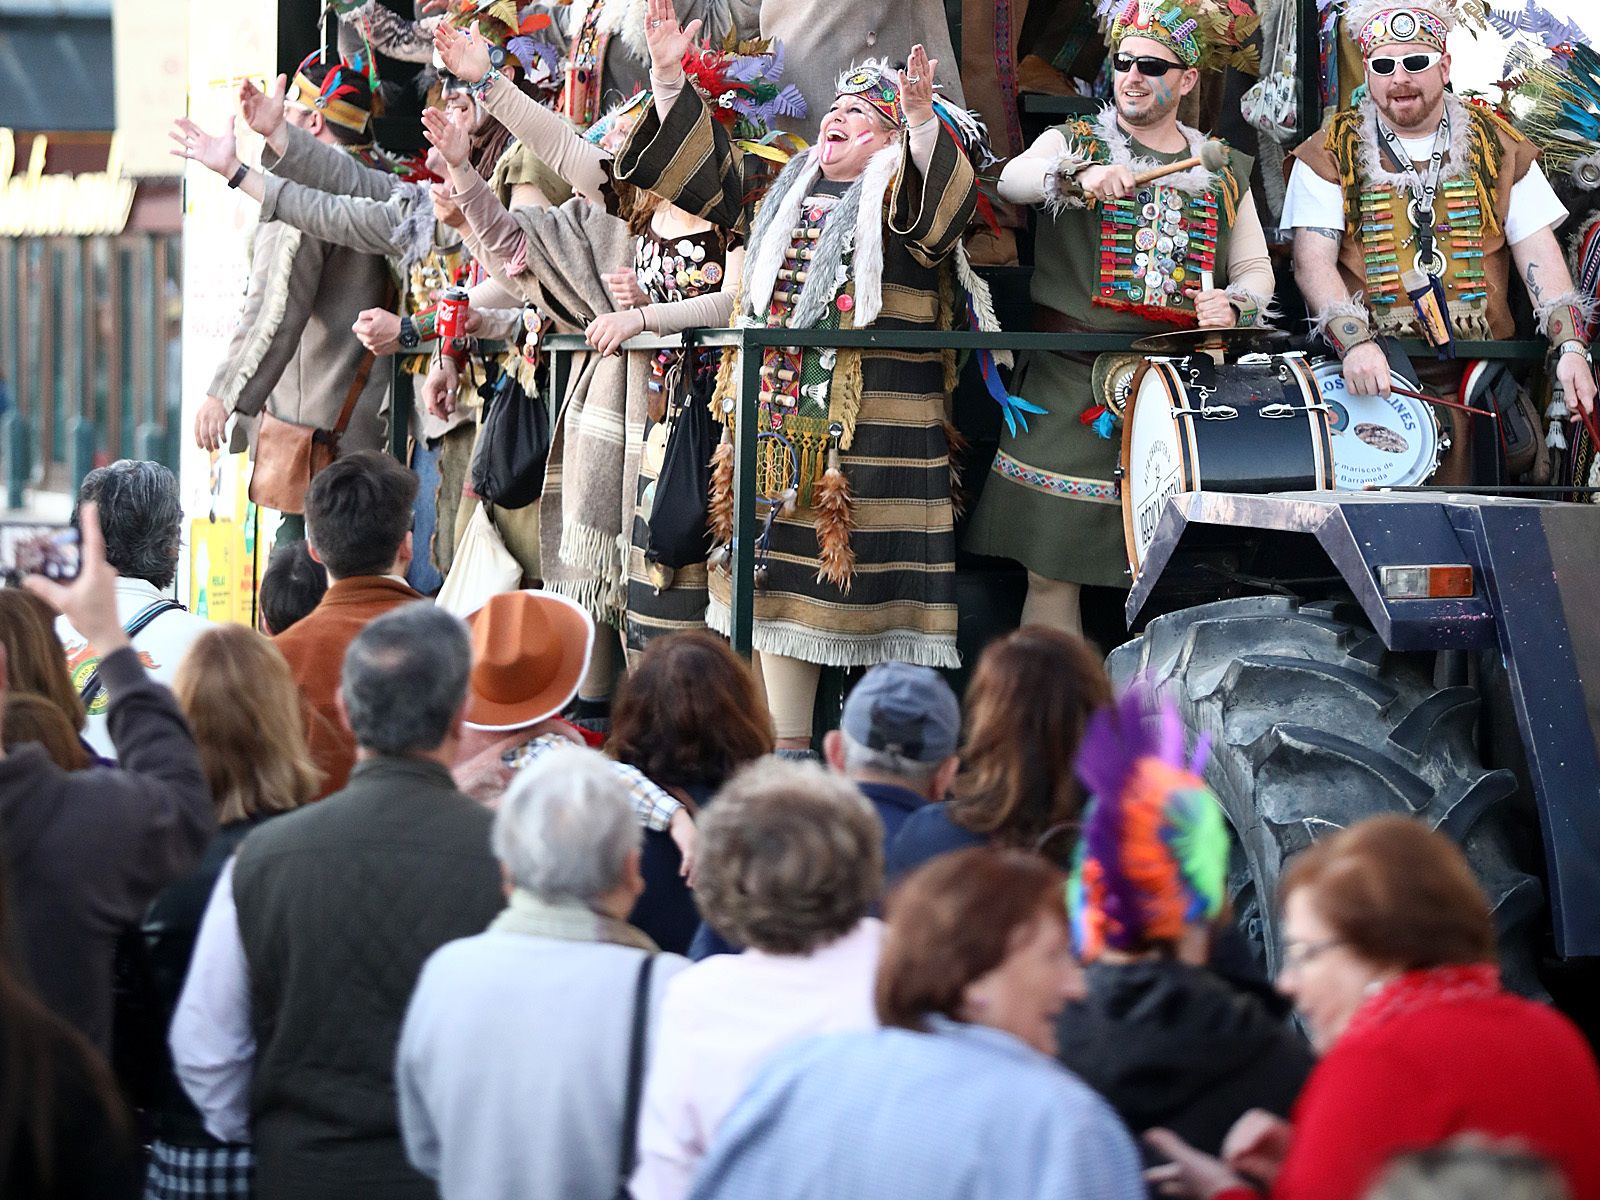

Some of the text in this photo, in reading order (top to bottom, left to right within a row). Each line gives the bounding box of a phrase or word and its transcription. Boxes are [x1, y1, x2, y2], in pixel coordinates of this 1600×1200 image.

[1322, 377, 1345, 394] OS
[1341, 463, 1382, 473] mariscos
[1383, 461, 1394, 470] de
[1340, 473, 1388, 484] Barrameda
